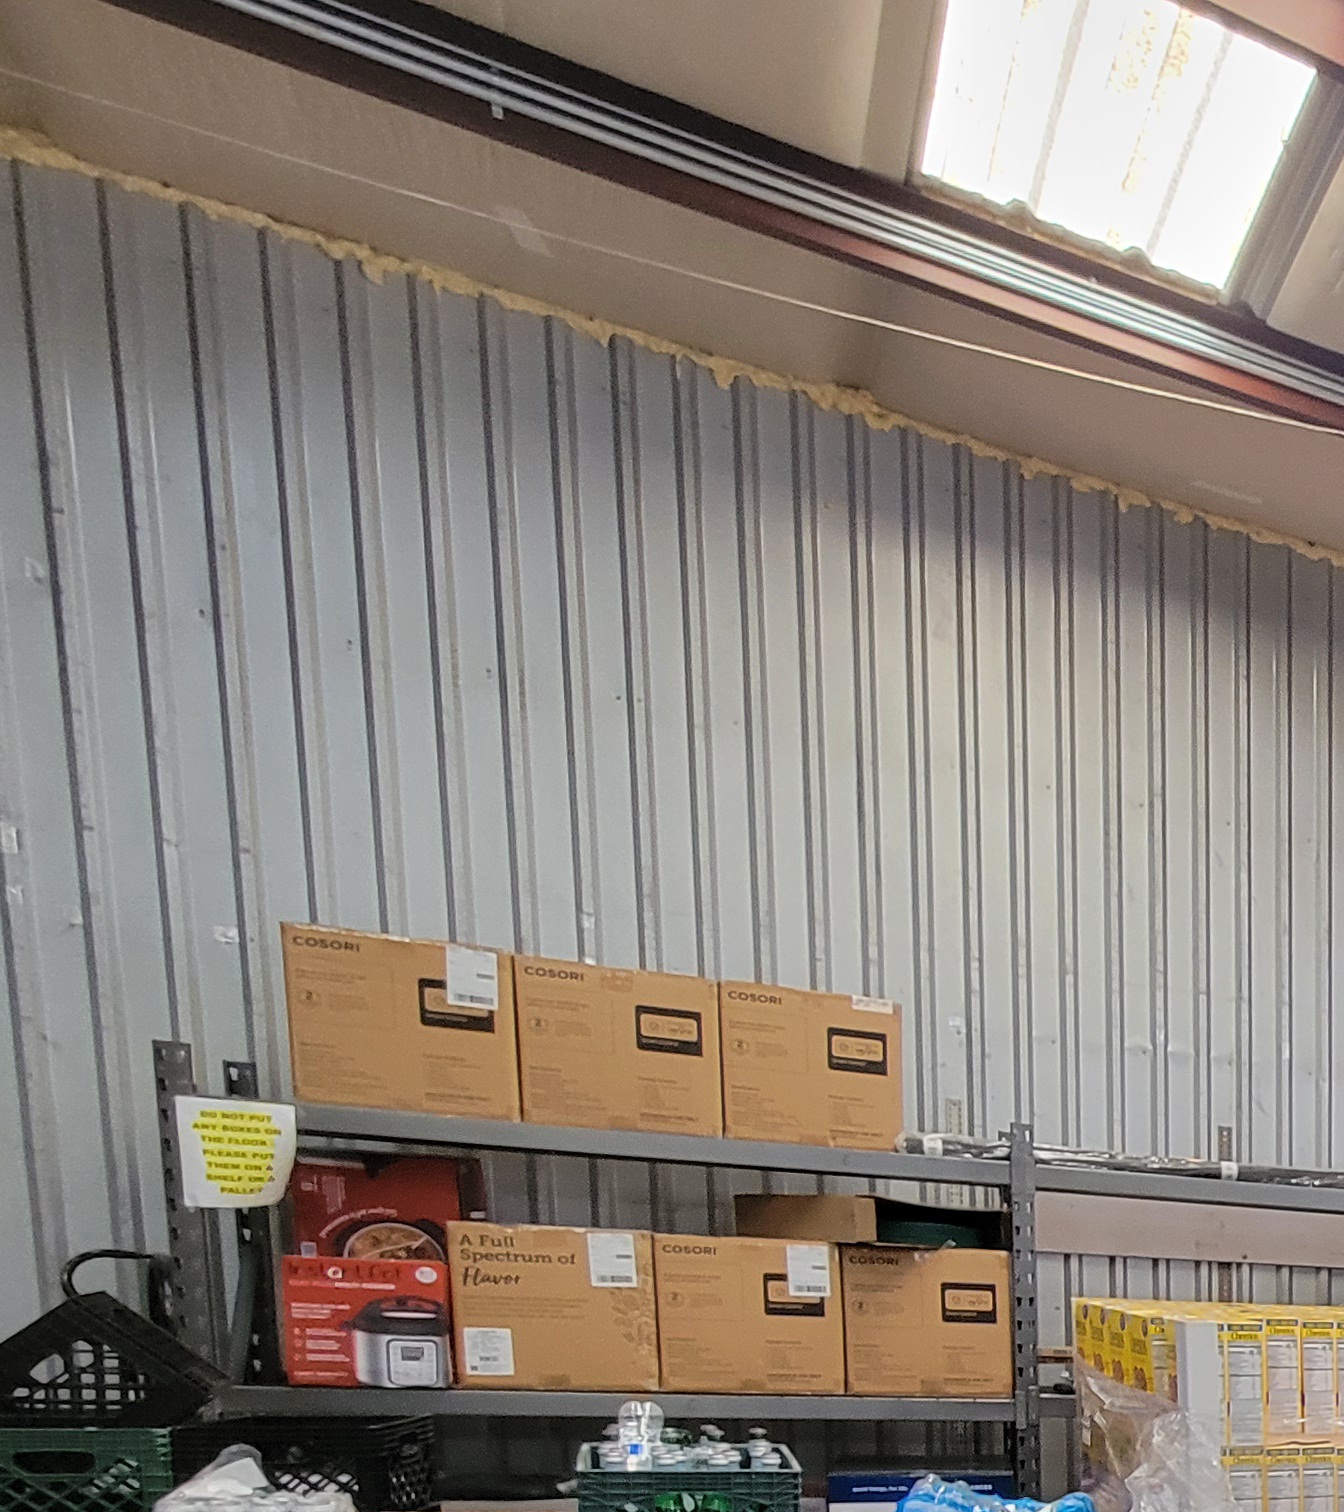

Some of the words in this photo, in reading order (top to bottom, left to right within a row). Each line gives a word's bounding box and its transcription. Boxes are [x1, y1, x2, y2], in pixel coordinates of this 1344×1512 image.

[293, 935, 360, 953] COSORI
[524, 965, 585, 982] COSORI
[727, 990, 783, 1006] COSORI
[200, 1110, 218, 1118] DO
[249, 1114, 273, 1123] PUT
[192, 1122, 216, 1130] ANY
[222, 1124, 260, 1133] BOXES
[263, 1128, 281, 1136] ON
[201, 1134, 224, 1143] THE
[227, 1136, 267, 1146] FLOOR
[202, 1148, 247, 1158] PLEASE
[251, 1152, 275, 1160] PUT
[206, 1161, 241, 1169] THEM
[244, 1163, 263, 1171] ON
[206, 1172, 242, 1182] SHELF
[459, 1234, 473, 1247] A
[478, 1234, 515, 1248] Full
[459, 1248, 553, 1265] Spectrum
[557, 1253, 576, 1266] of
[661, 1243, 718, 1257] COSORI
[848, 1254, 900, 1267] COSORI
[462, 1266, 522, 1288] Flavor
